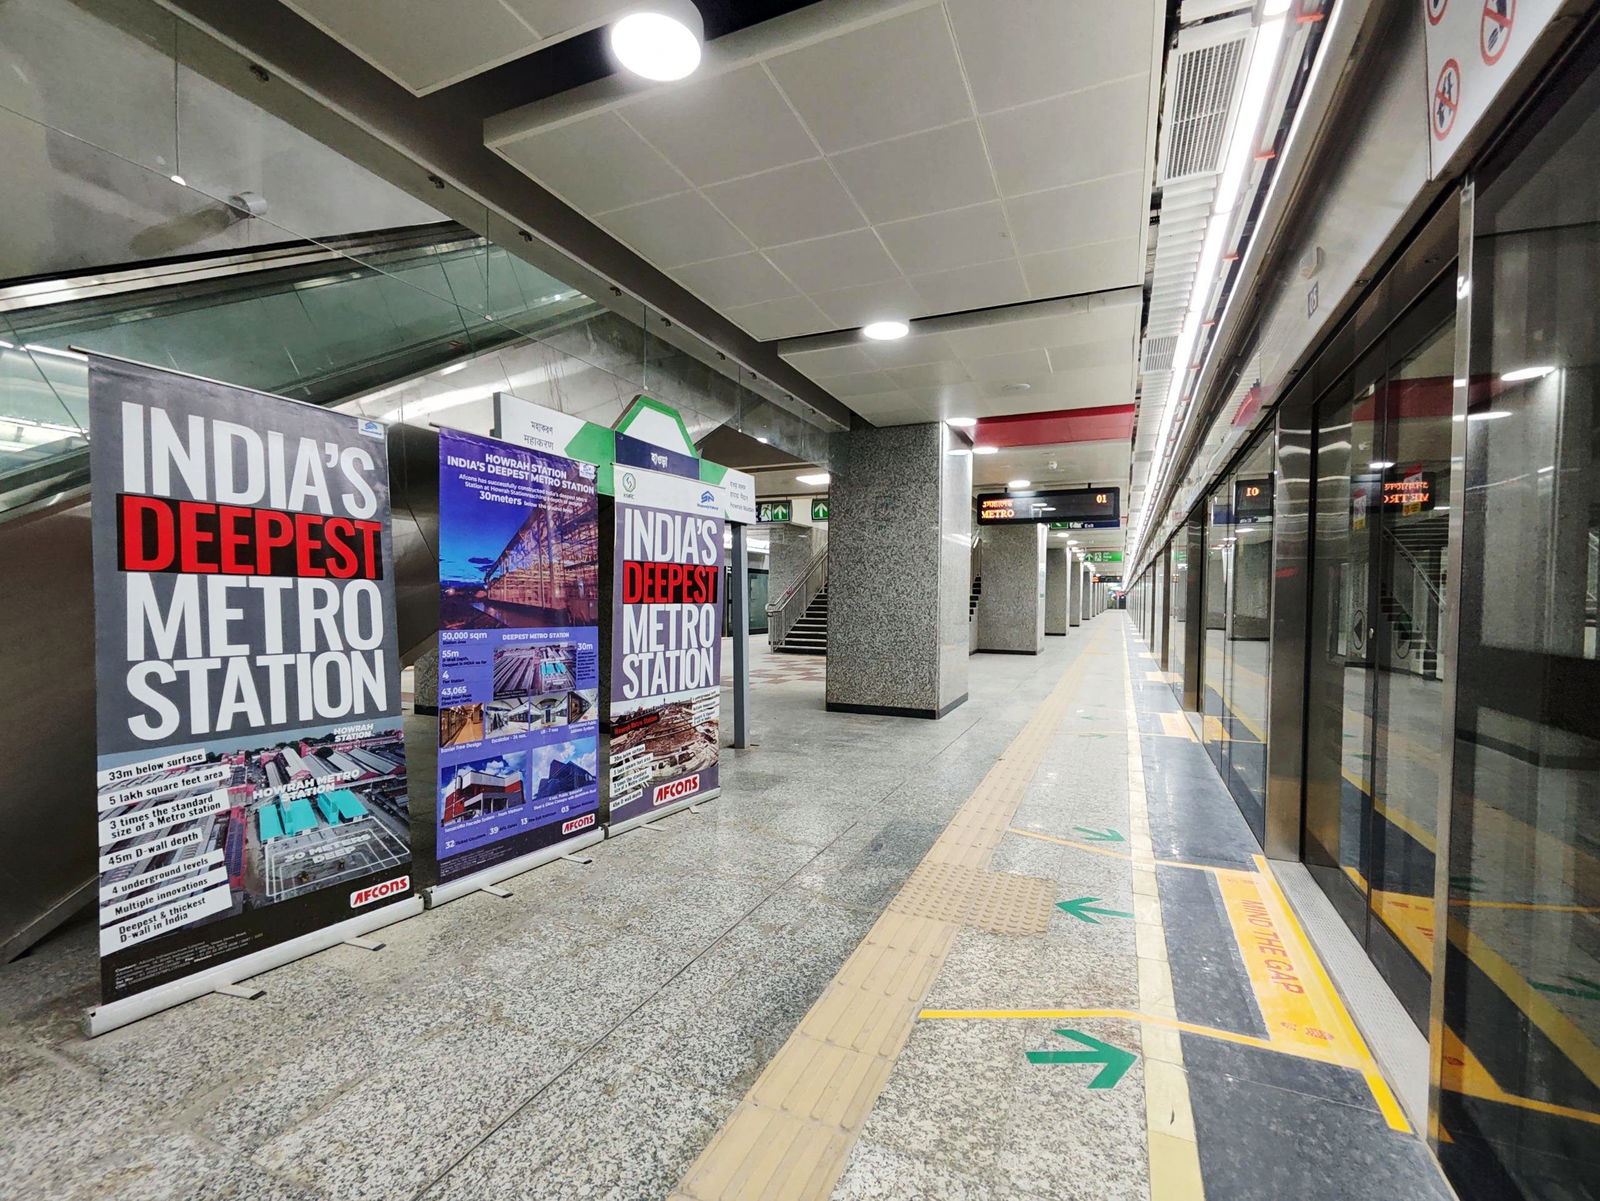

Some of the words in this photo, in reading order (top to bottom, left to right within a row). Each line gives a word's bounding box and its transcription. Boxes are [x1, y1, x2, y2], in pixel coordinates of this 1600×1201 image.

[524, 435, 554, 450] महाकरण
[122, 401, 377, 519] INDIA'S
[447, 456, 486, 472] INDIA'S
[488, 464, 530, 481] DEEPEST
[530, 472, 560, 487] METRO
[562, 480, 595, 494] STATION
[486, 453, 530, 470] HOWRAH
[532, 464, 567, 479] STATION
[458, 474, 478, 483] Afcons
[488, 478, 518, 490] successfully
[518, 484, 546, 494] constructed
[465, 482, 483, 490] Station
[490, 486, 510, 495] Howrah
[1096, 494, 1107, 504] 01
[982, 510, 1014, 519] METRO
[123, 496, 382, 579] DEEPEST
[623, 508, 718, 566] INDIA'S
[623, 562, 718, 604] DEEPEST
[127, 572, 384, 661] METRO
[623, 603, 716, 654] METRO
[442, 632, 468, 641] 50,000
[470, 632, 488, 640] sqm
[577, 642, 593, 650] 30m
[442, 670, 449, 679] 4
[622, 647, 714, 700] STATION
[127, 650, 387, 741] STATION
[333, 723, 374, 735] HOWRAH
[335, 731, 372, 743] STATION
[109, 769, 132, 781] 33m
[136, 762, 164, 774] below
[167, 753, 203, 767] surface
[109, 796, 116, 805] 5
[120, 790, 143, 803] lakh
[146, 781, 179, 798] square
[182, 774, 201, 787] feet
[204, 771, 223, 781] area
[253, 778, 315, 800] HOWRAH
[316, 769, 360, 786] METRO
[281, 783, 335, 801] STATION
[655, 776, 698, 802] AFCONS
[110, 821, 117, 830] 3
[120, 813, 150, 827] times
[153, 807, 168, 818] the
[172, 794, 214, 812] standard
[111, 827, 132, 839] size
[136, 823, 146, 832] of
[158, 812, 186, 826] Metro
[189, 802, 221, 817] station
[563, 816, 594, 833] AFCONS
[444, 840, 455, 850] 32
[490, 826, 499, 836] 39
[108, 853, 132, 865] 45m
[136, 842, 167, 857] D-wall
[170, 832, 198, 847] depth
[112, 886, 118, 894] 4
[122, 866, 181, 892] underground
[184, 858, 208, 871] levels
[115, 898, 154, 916] Multiple
[157, 878, 208, 901] innovations
[353, 878, 408, 905] AFCONS
[119, 915, 157, 934] Deepest
[160, 911, 167, 920] &
[170, 897, 206, 916] thickest
[120, 927, 151, 943] D-wall
[154, 922, 162, 930] in
[166, 912, 188, 926] India
[1241, 899, 1273, 927] MIND
[1254, 928, 1288, 958] THE
[1264, 959, 1304, 995] GAP
